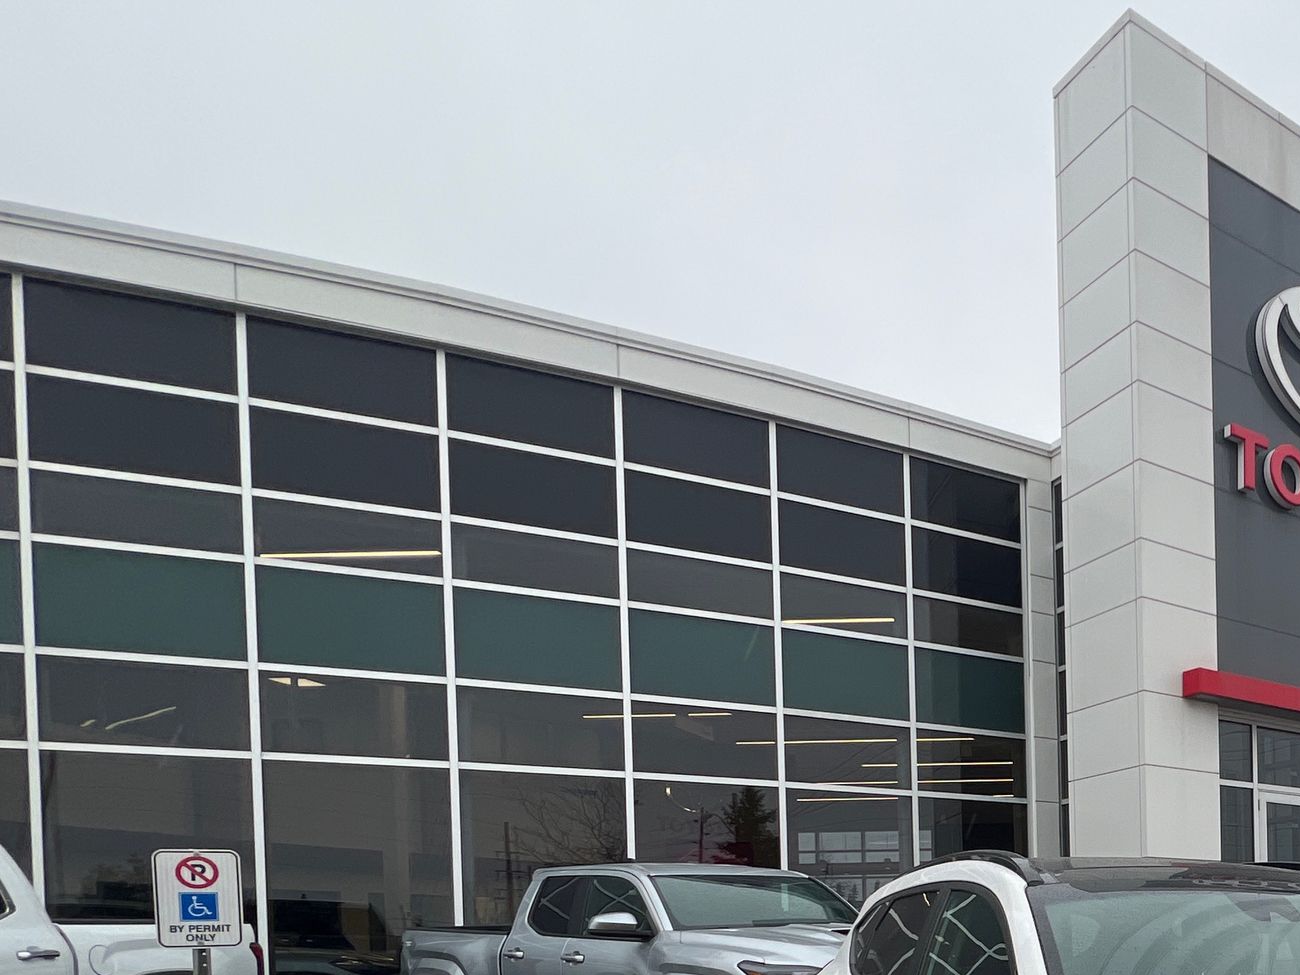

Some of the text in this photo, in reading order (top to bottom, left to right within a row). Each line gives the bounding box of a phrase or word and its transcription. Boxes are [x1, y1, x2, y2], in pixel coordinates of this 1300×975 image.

[170, 924, 231, 933] BY PERMIT
[186, 933, 216, 942] ONLY
